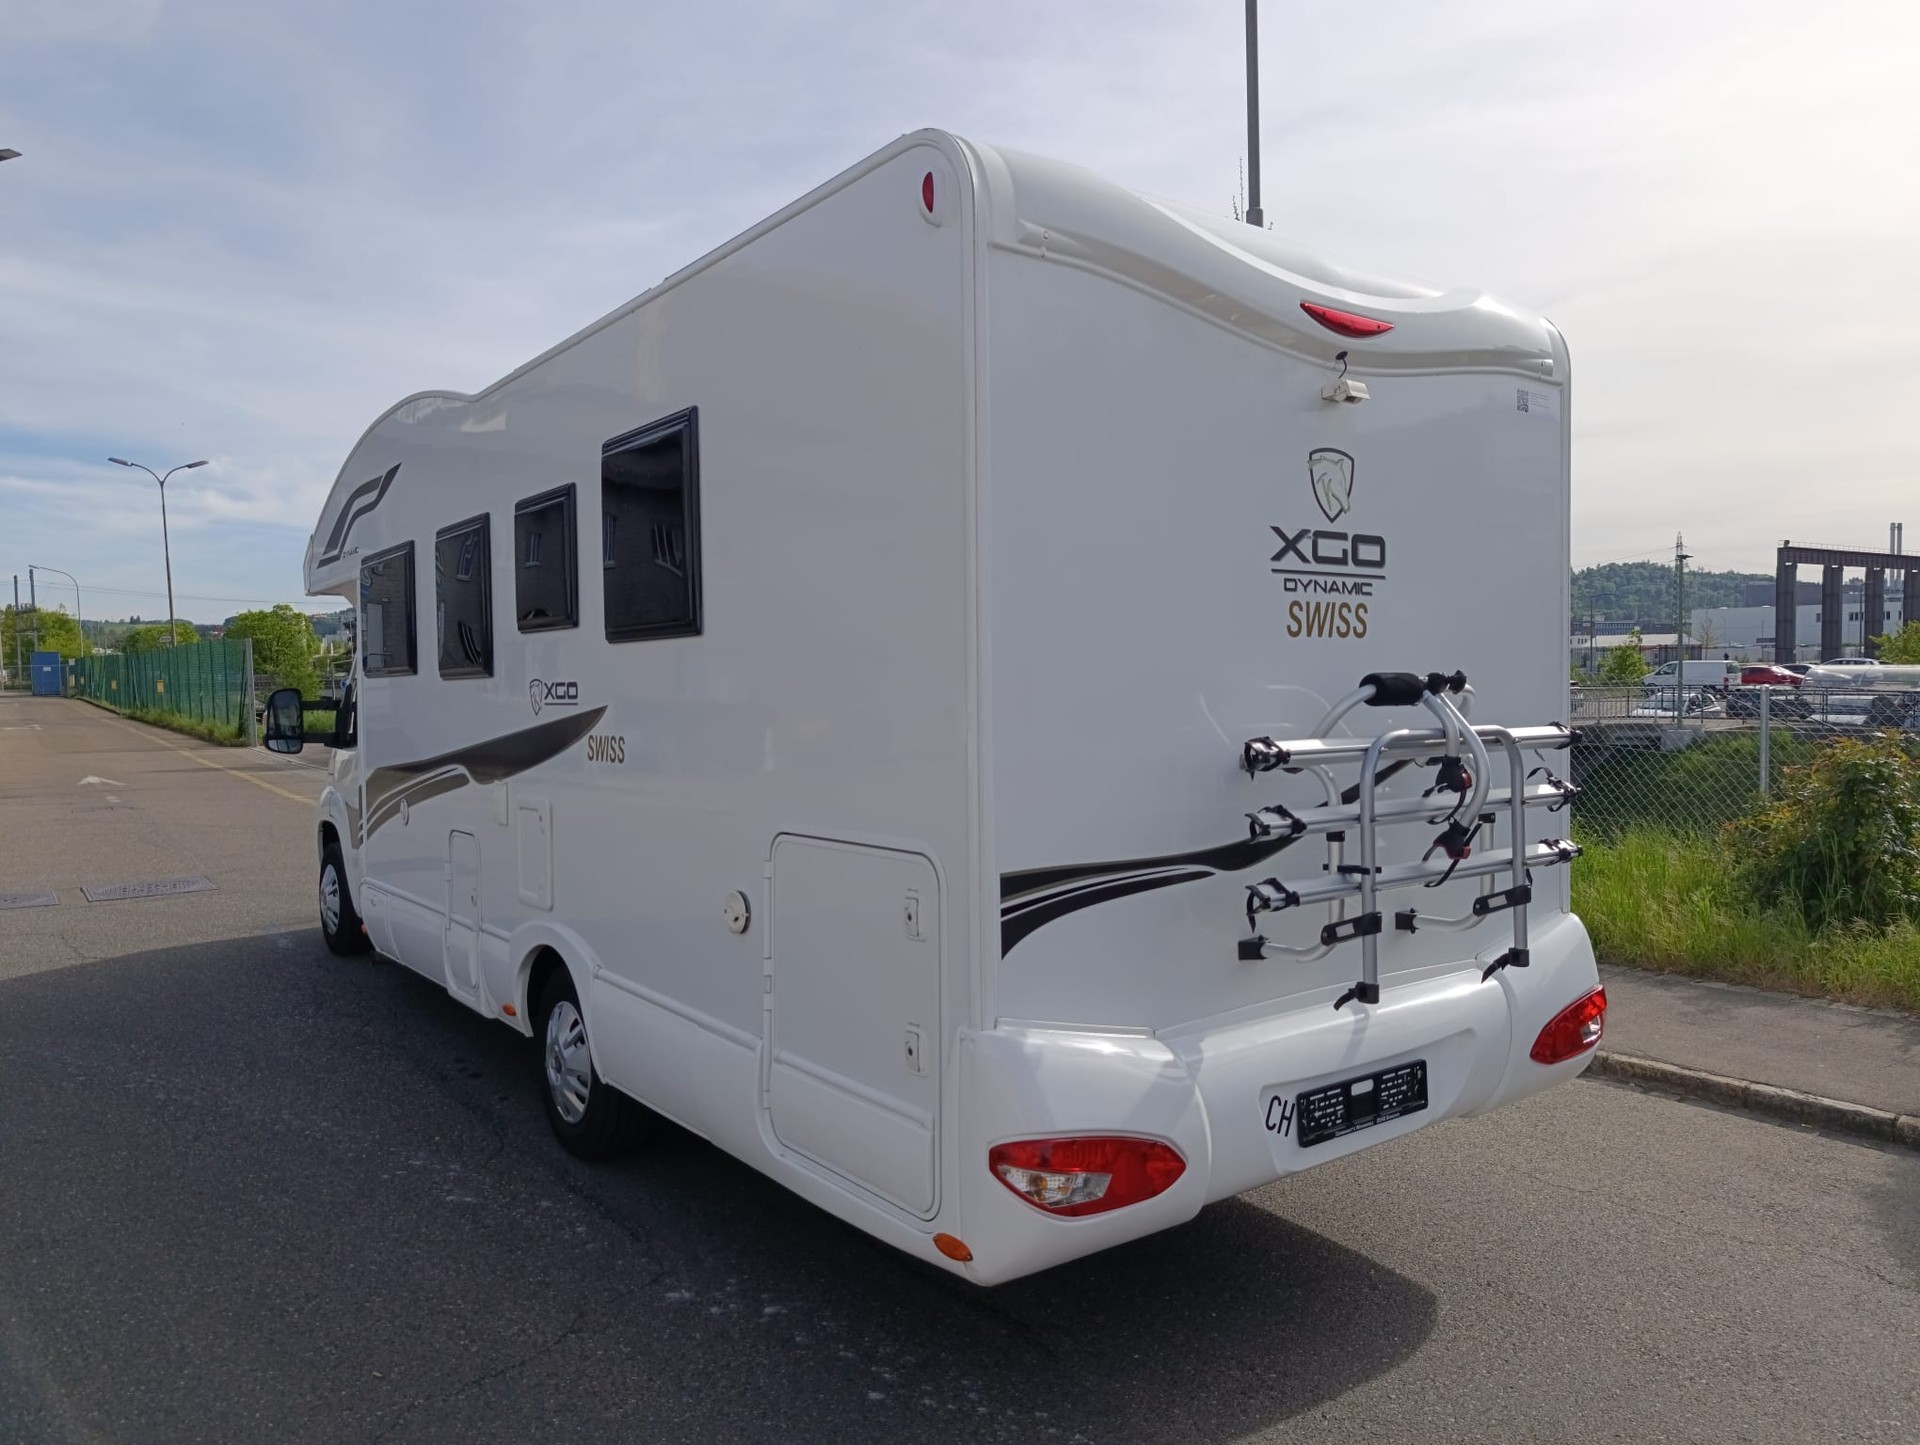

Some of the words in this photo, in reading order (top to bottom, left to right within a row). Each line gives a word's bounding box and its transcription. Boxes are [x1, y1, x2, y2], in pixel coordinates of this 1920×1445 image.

[1269, 525, 1386, 569] XGO
[1283, 577, 1373, 597] DYNAMIC
[1286, 600, 1369, 639] SWISS
[544, 681, 579, 700] XGO
[587, 734, 626, 764] SWISS
[1265, 1095, 1296, 1137] CH
